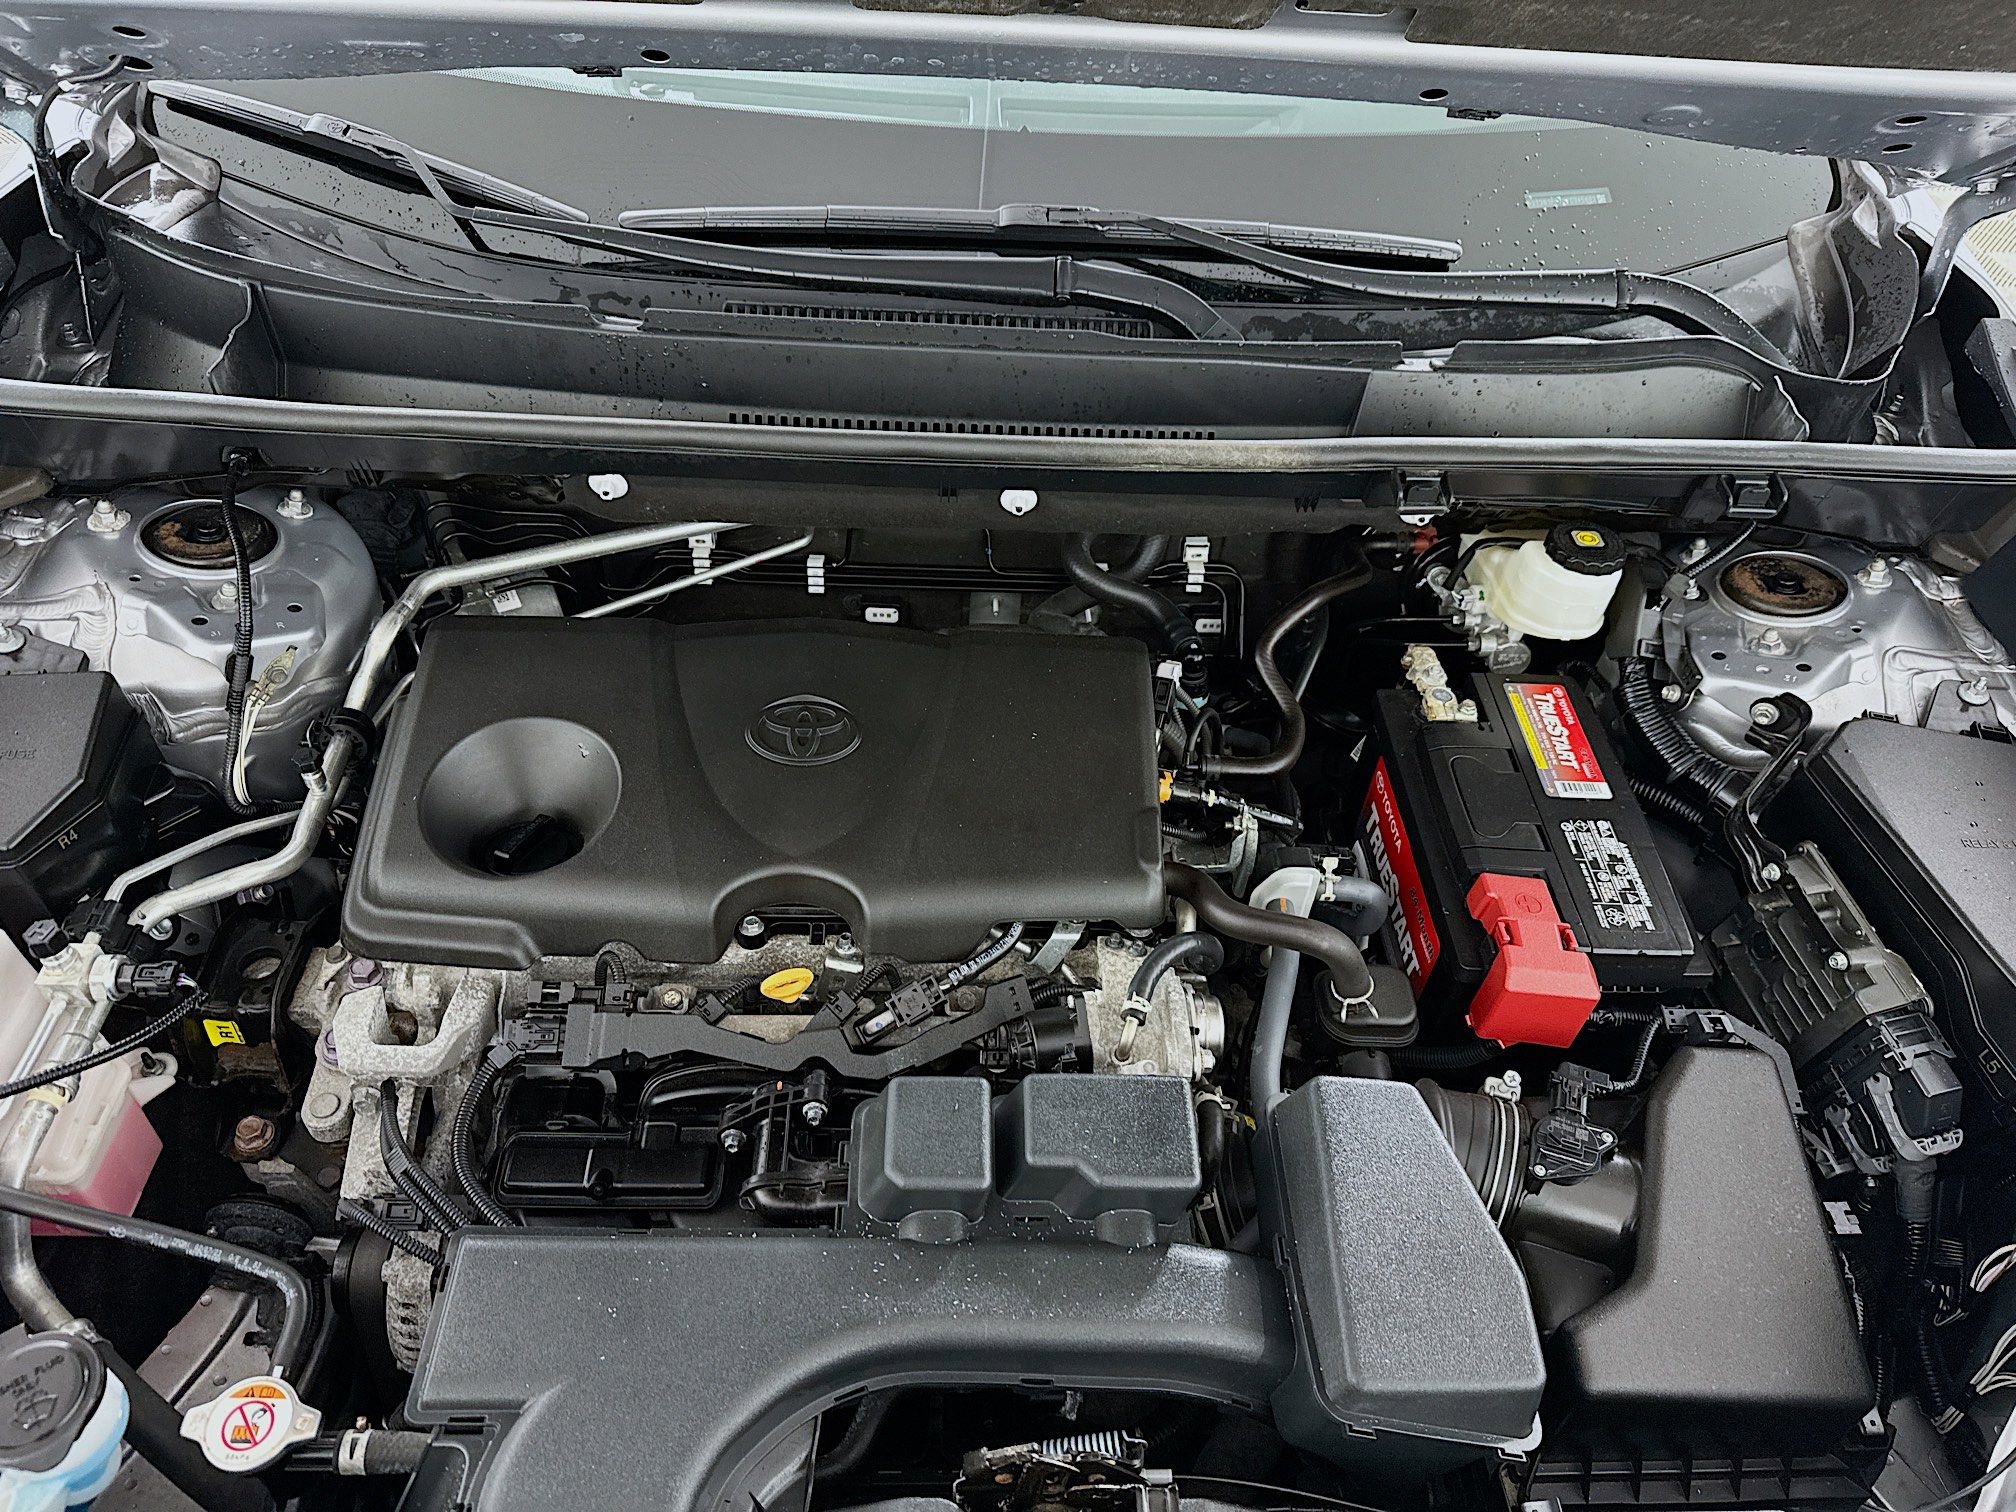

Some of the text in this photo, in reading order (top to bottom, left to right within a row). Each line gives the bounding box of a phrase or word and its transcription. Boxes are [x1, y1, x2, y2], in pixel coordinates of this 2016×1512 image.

[1558, 698, 1576, 725] TOYOTA
[1382, 792, 1402, 854] TOYOTA
[57, 829, 78, 850] R4
[1960, 838, 2000, 849] RELAY
[216, 1025, 235, 1038] R1
[1979, 1048, 2001, 1073] L5
